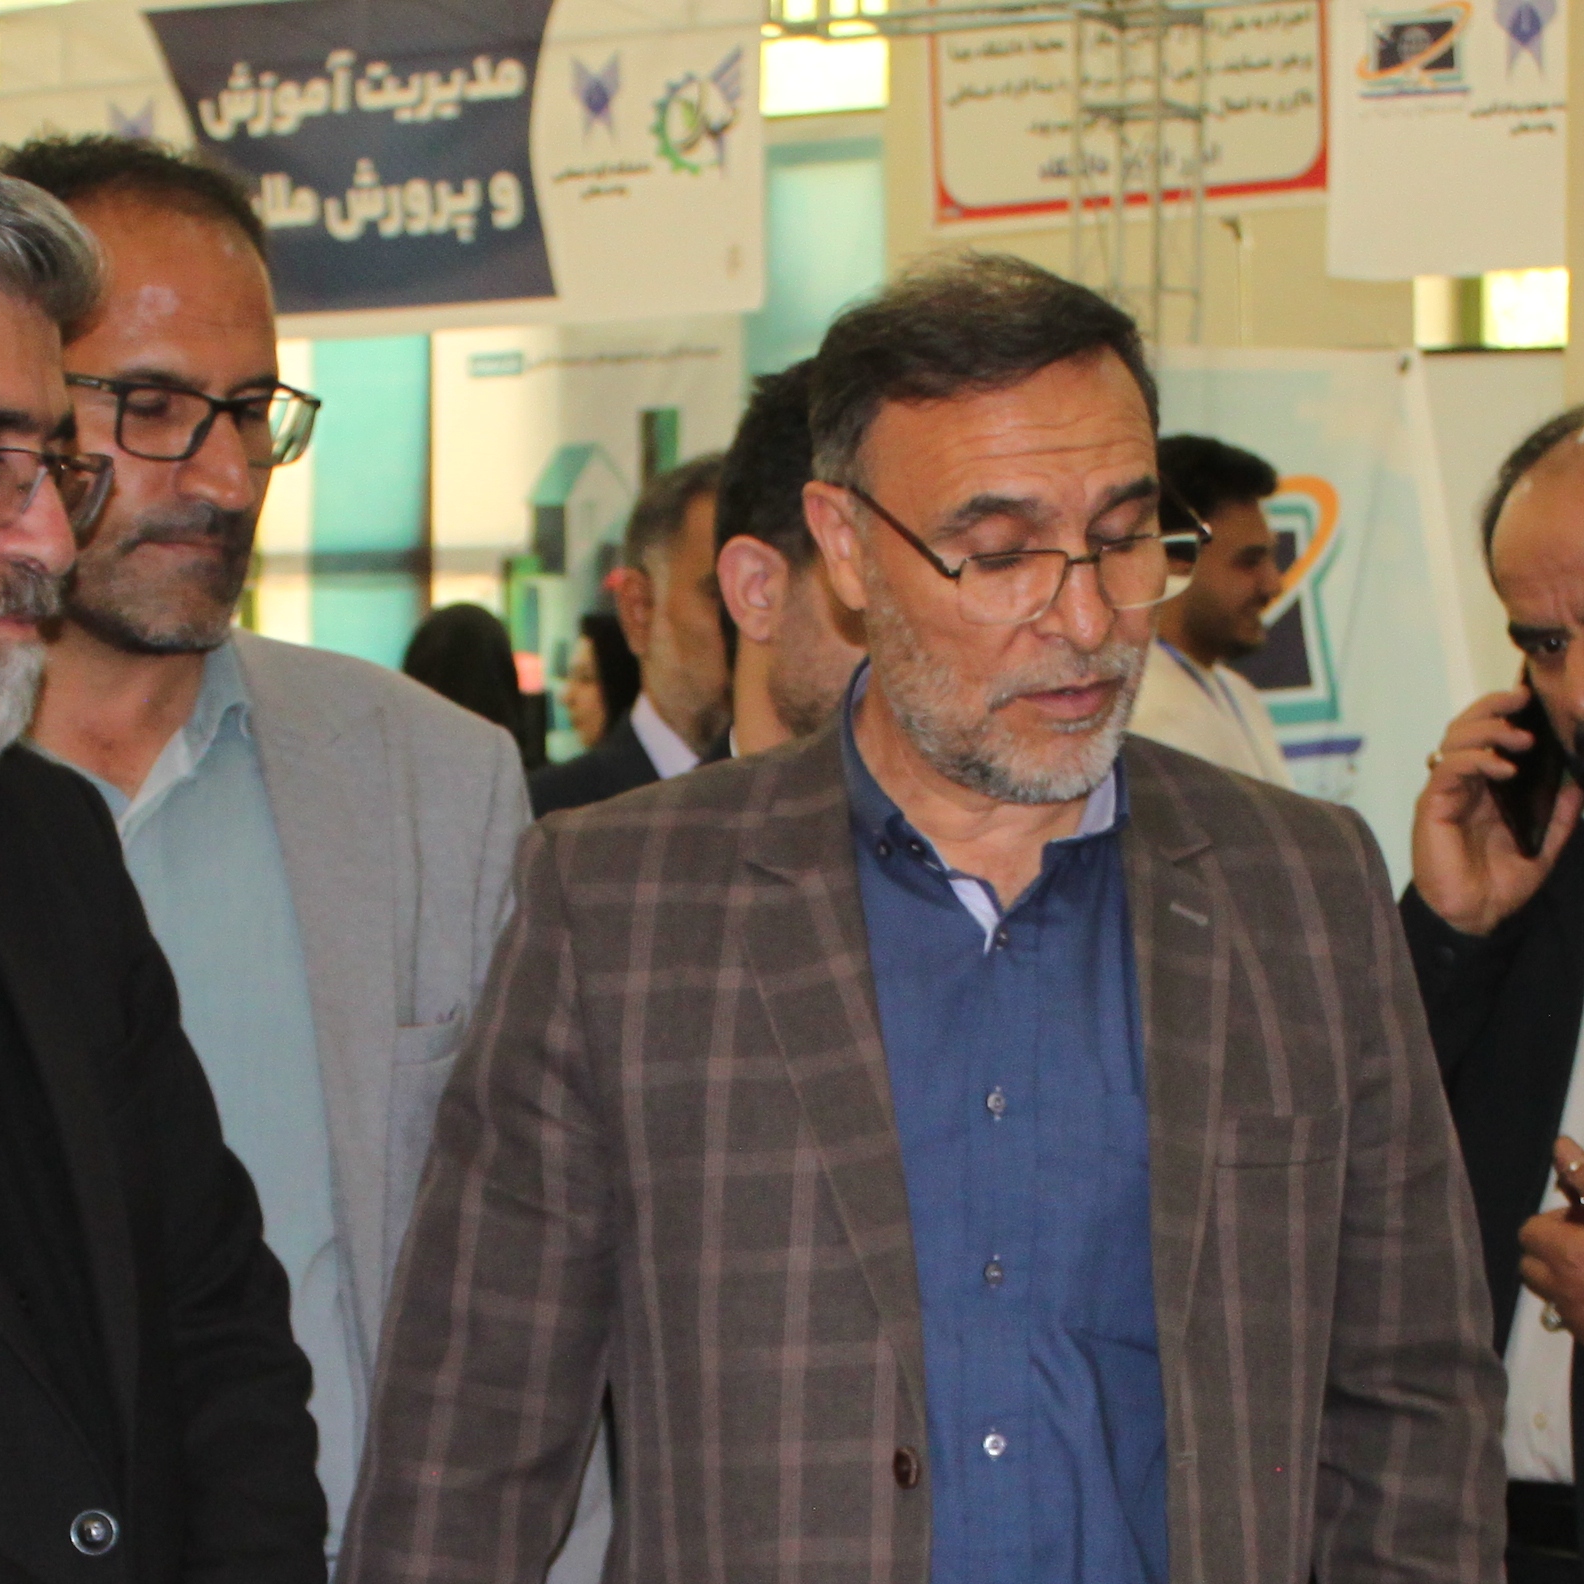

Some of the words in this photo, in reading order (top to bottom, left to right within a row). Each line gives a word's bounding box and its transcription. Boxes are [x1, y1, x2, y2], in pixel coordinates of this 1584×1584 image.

[198, 48, 355, 142] آموزش
[355, 52, 528, 124] مدیریت
[323, 157, 483, 244] پرورش
[487, 170, 525, 231] و
